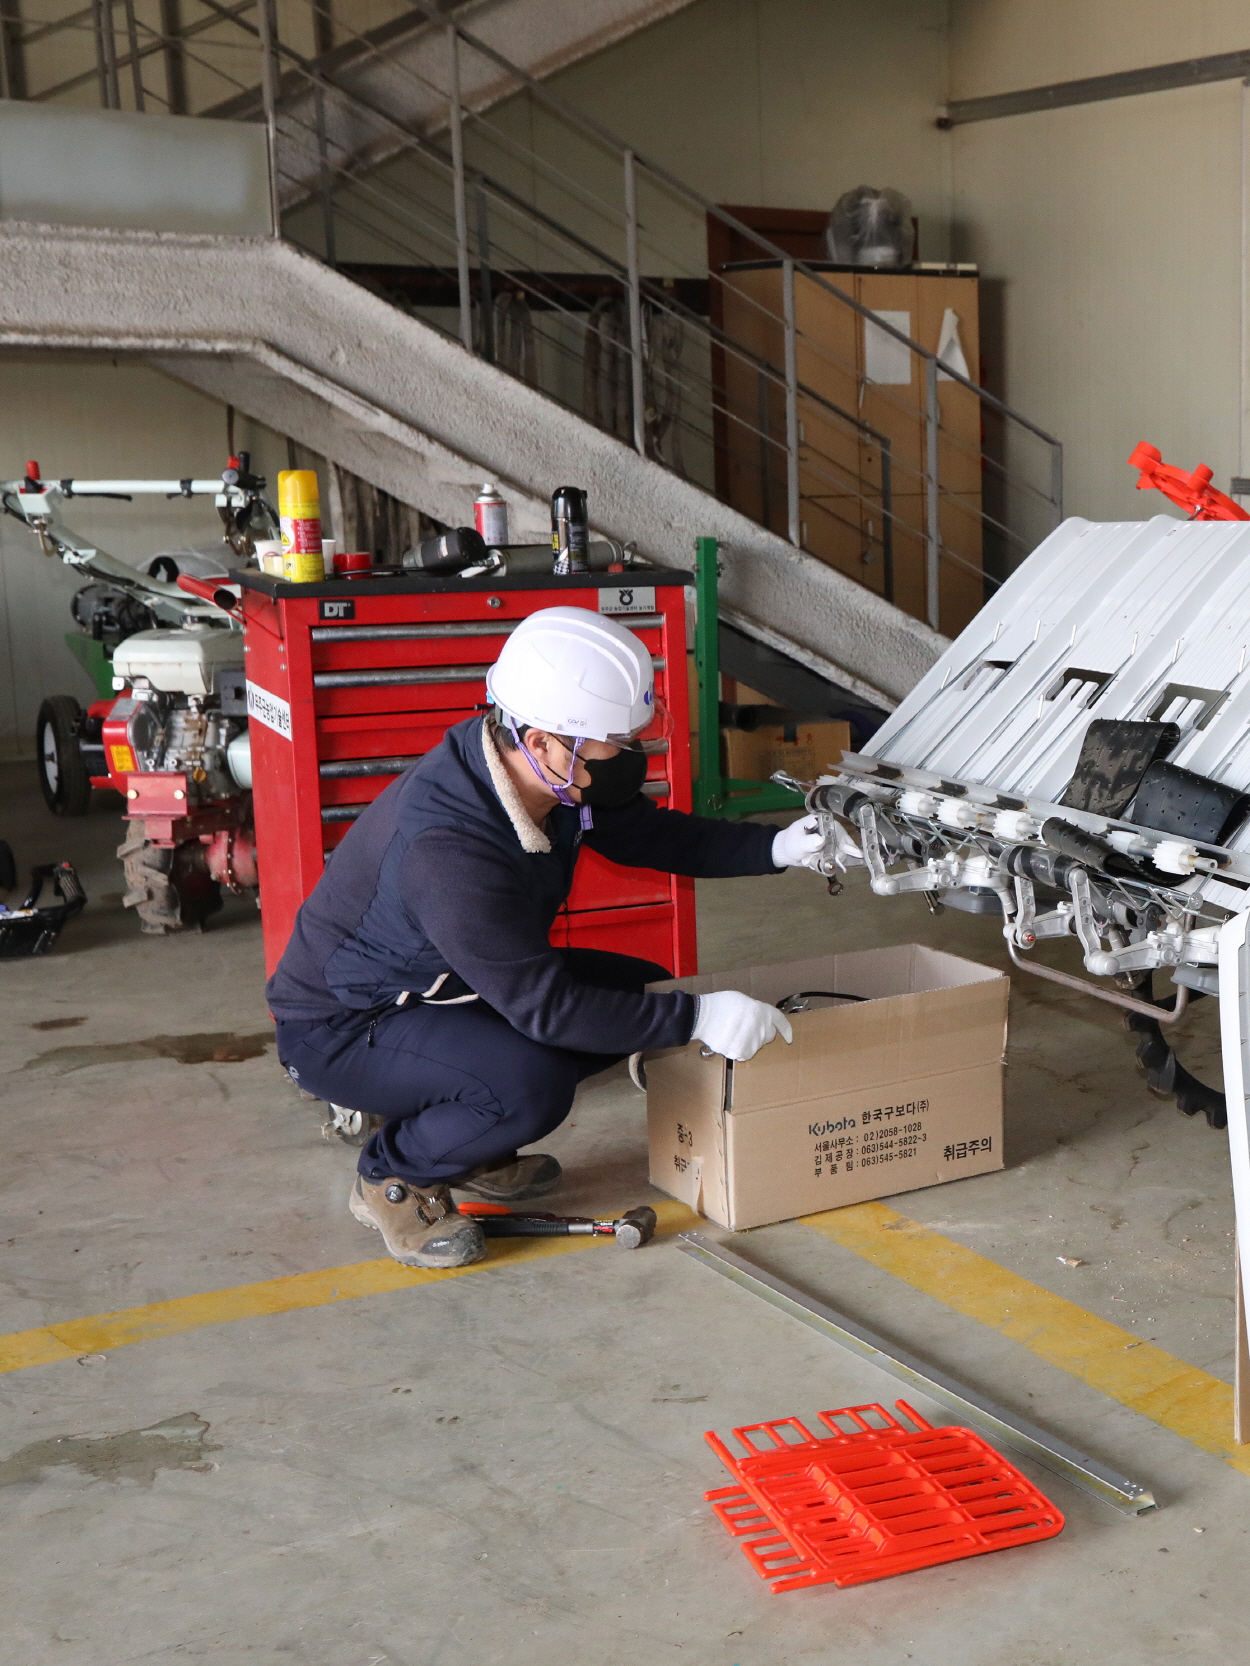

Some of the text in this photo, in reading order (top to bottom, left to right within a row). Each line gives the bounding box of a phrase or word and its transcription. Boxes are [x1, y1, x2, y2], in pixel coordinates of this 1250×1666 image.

[324, 602, 347, 617] DT
[808, 1099, 930, 1136] Kubota 한국구보다(주)
[814, 1136, 854, 1152] 서울사무소
[864, 1122, 922, 1142] 02)2058-1028
[944, 1136, 992, 1162] 취급주의
[862, 1148, 917, 1167] 063)545-5821
